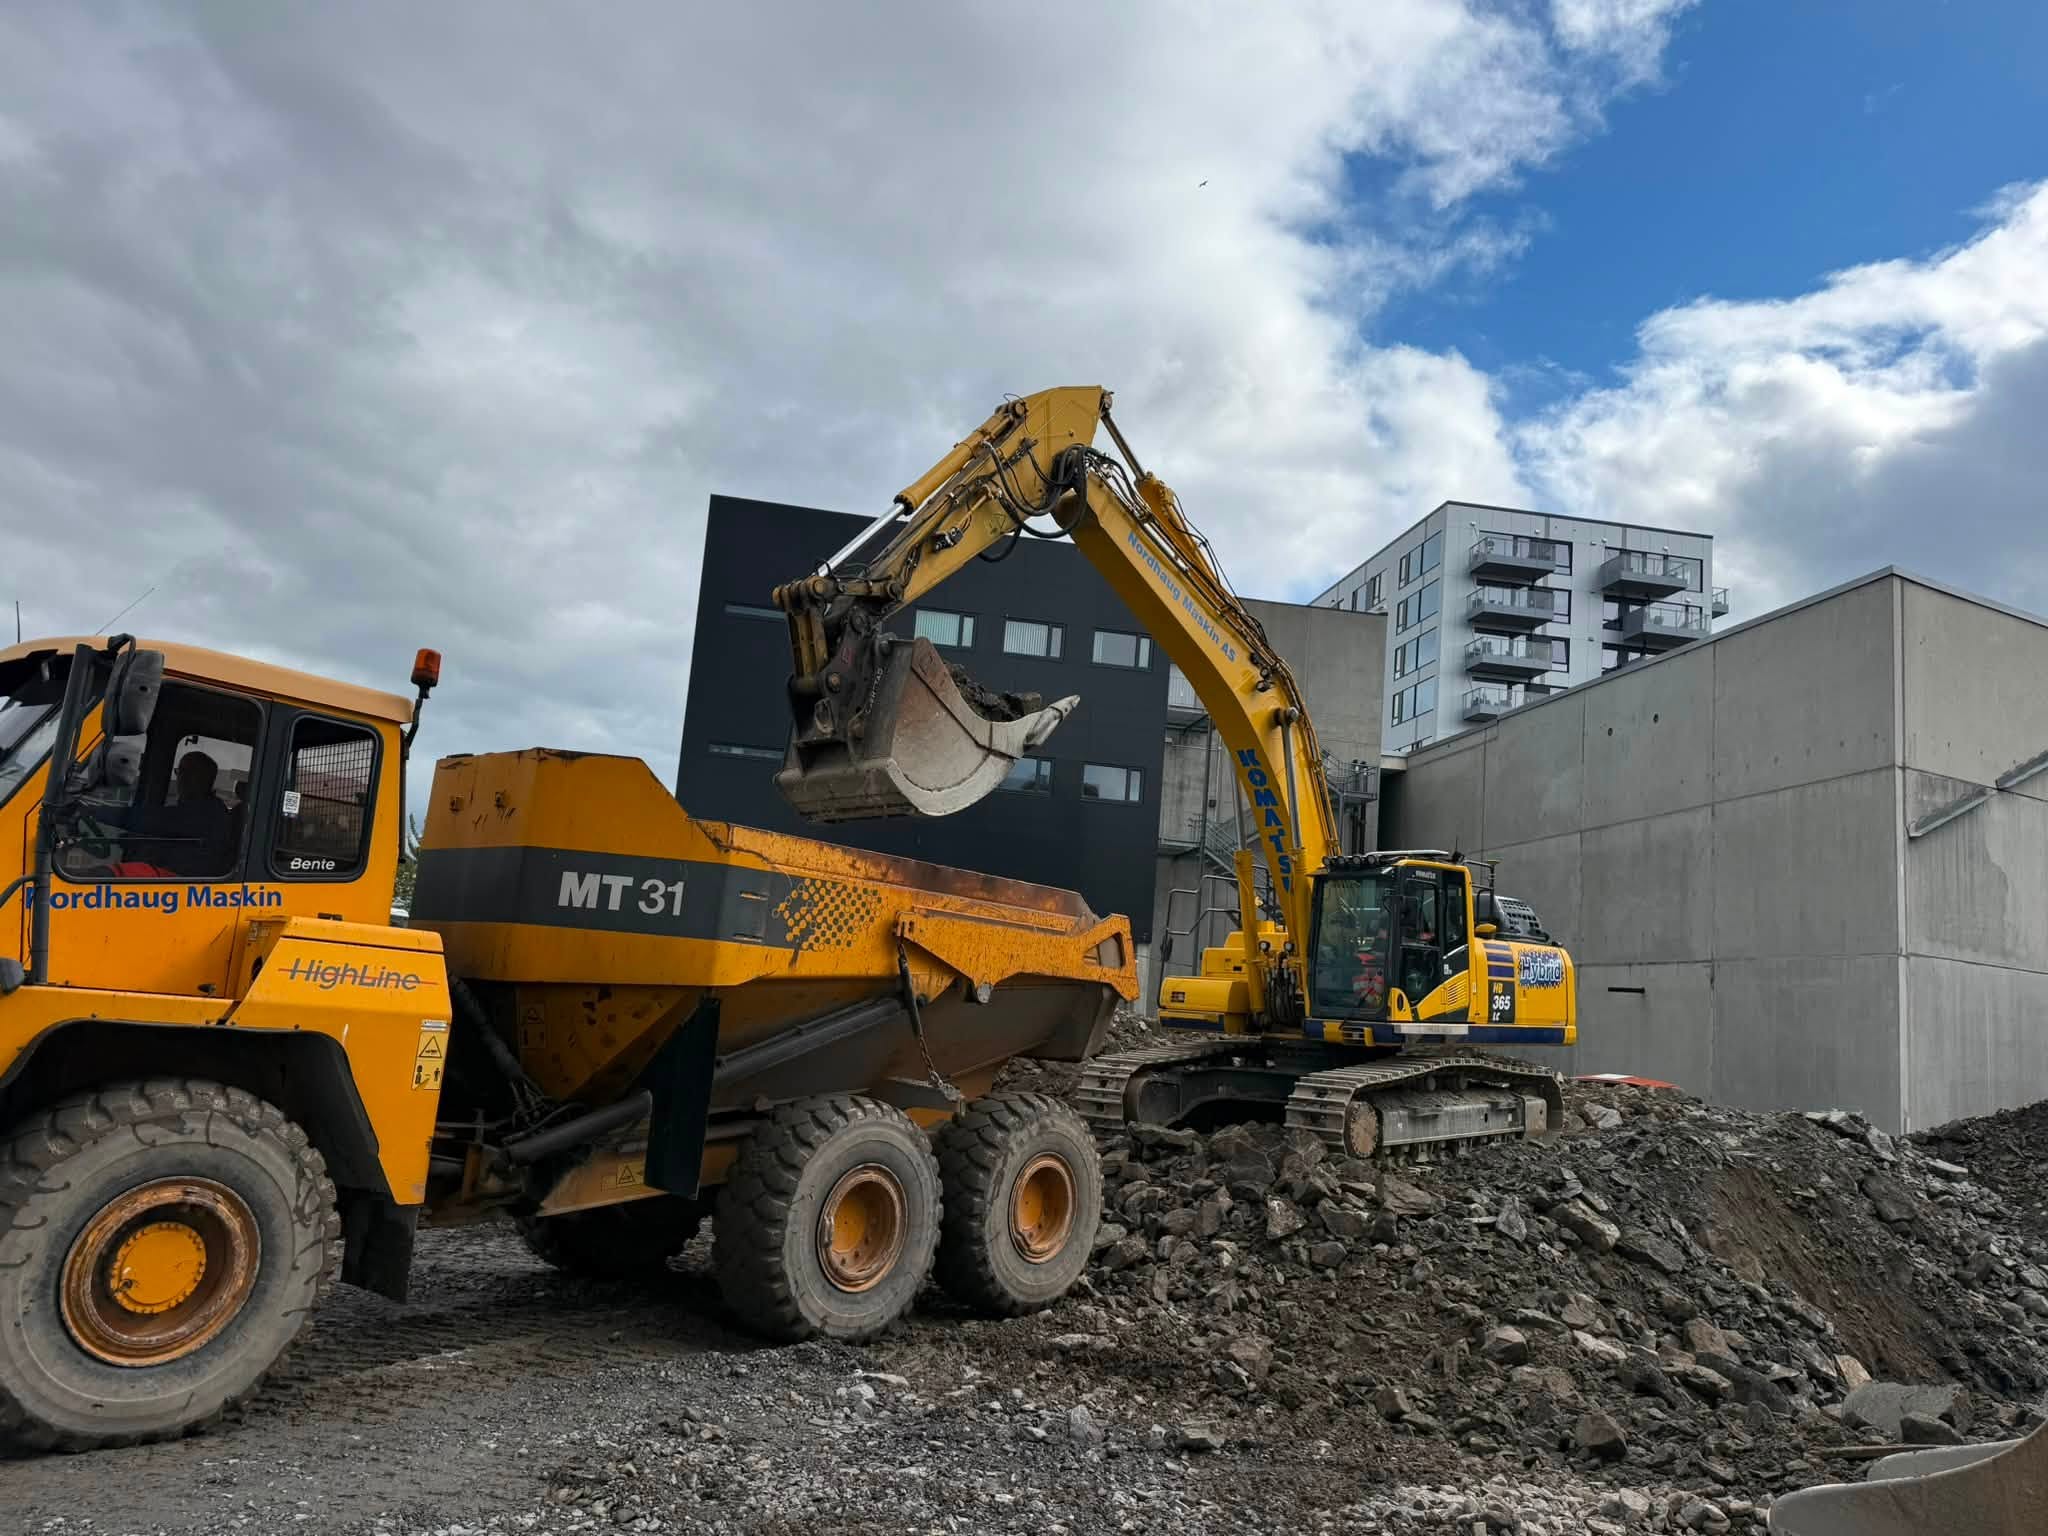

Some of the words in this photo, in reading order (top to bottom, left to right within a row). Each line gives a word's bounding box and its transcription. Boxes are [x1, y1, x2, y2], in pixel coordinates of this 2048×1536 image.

[1128, 531, 1181, 600] Nordhaug
[1182, 596, 1220, 644] Maskin
[1221, 642, 1236, 662] AS
[290, 857, 336, 870] Bente
[186, 886, 282, 908] Maskin
[558, 871, 634, 911] MT
[638, 879, 685, 916] 31
[289, 957, 421, 991] HighLine
[1520, 955, 1562, 984] Hybrid
[1493, 995, 1511, 1010] 365
